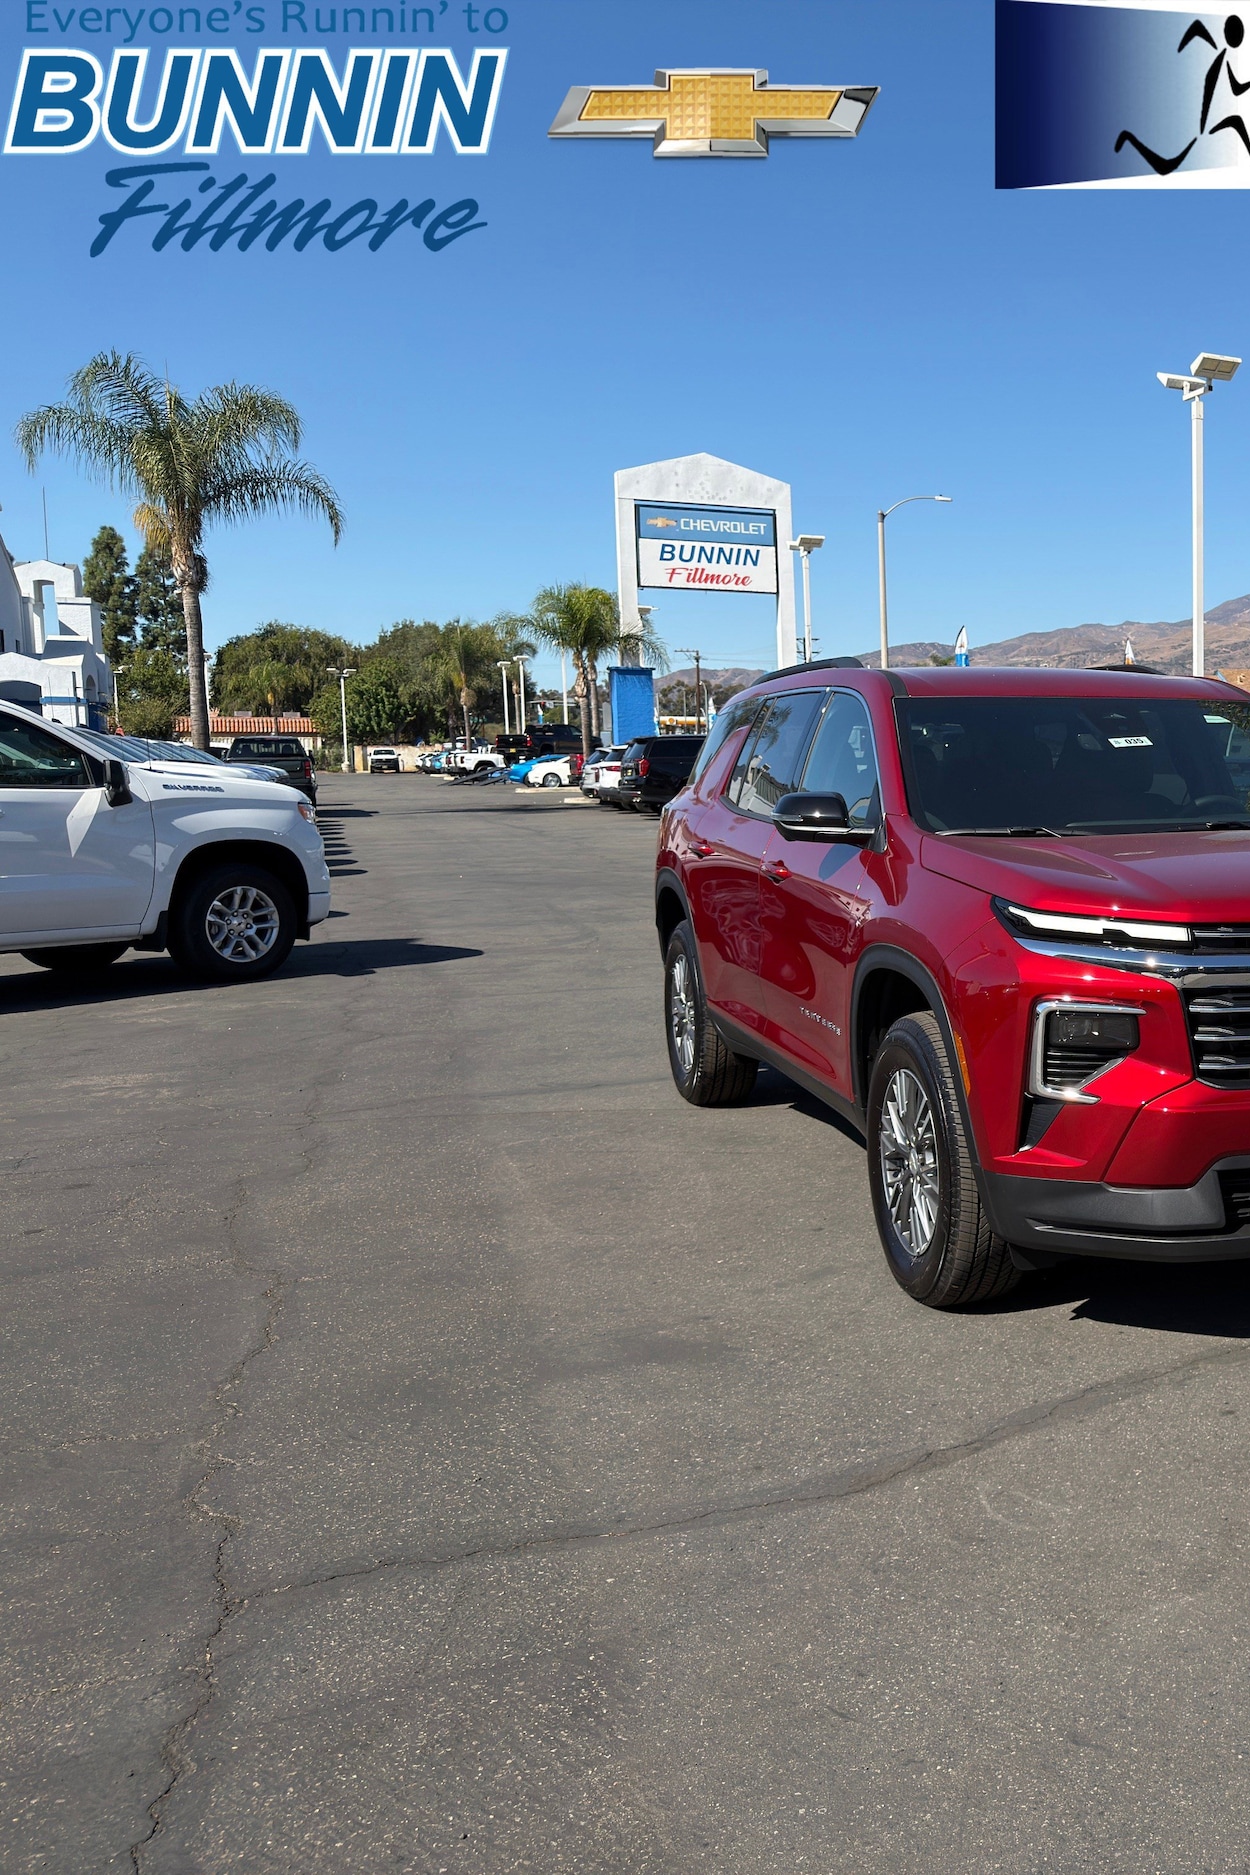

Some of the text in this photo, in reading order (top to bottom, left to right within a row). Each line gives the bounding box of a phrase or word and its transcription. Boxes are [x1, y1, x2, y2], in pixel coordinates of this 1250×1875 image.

[680, 518, 767, 535] CHEVROLET
[659, 543, 760, 567] BUNNIN
[665, 567, 753, 587] Fillmore
